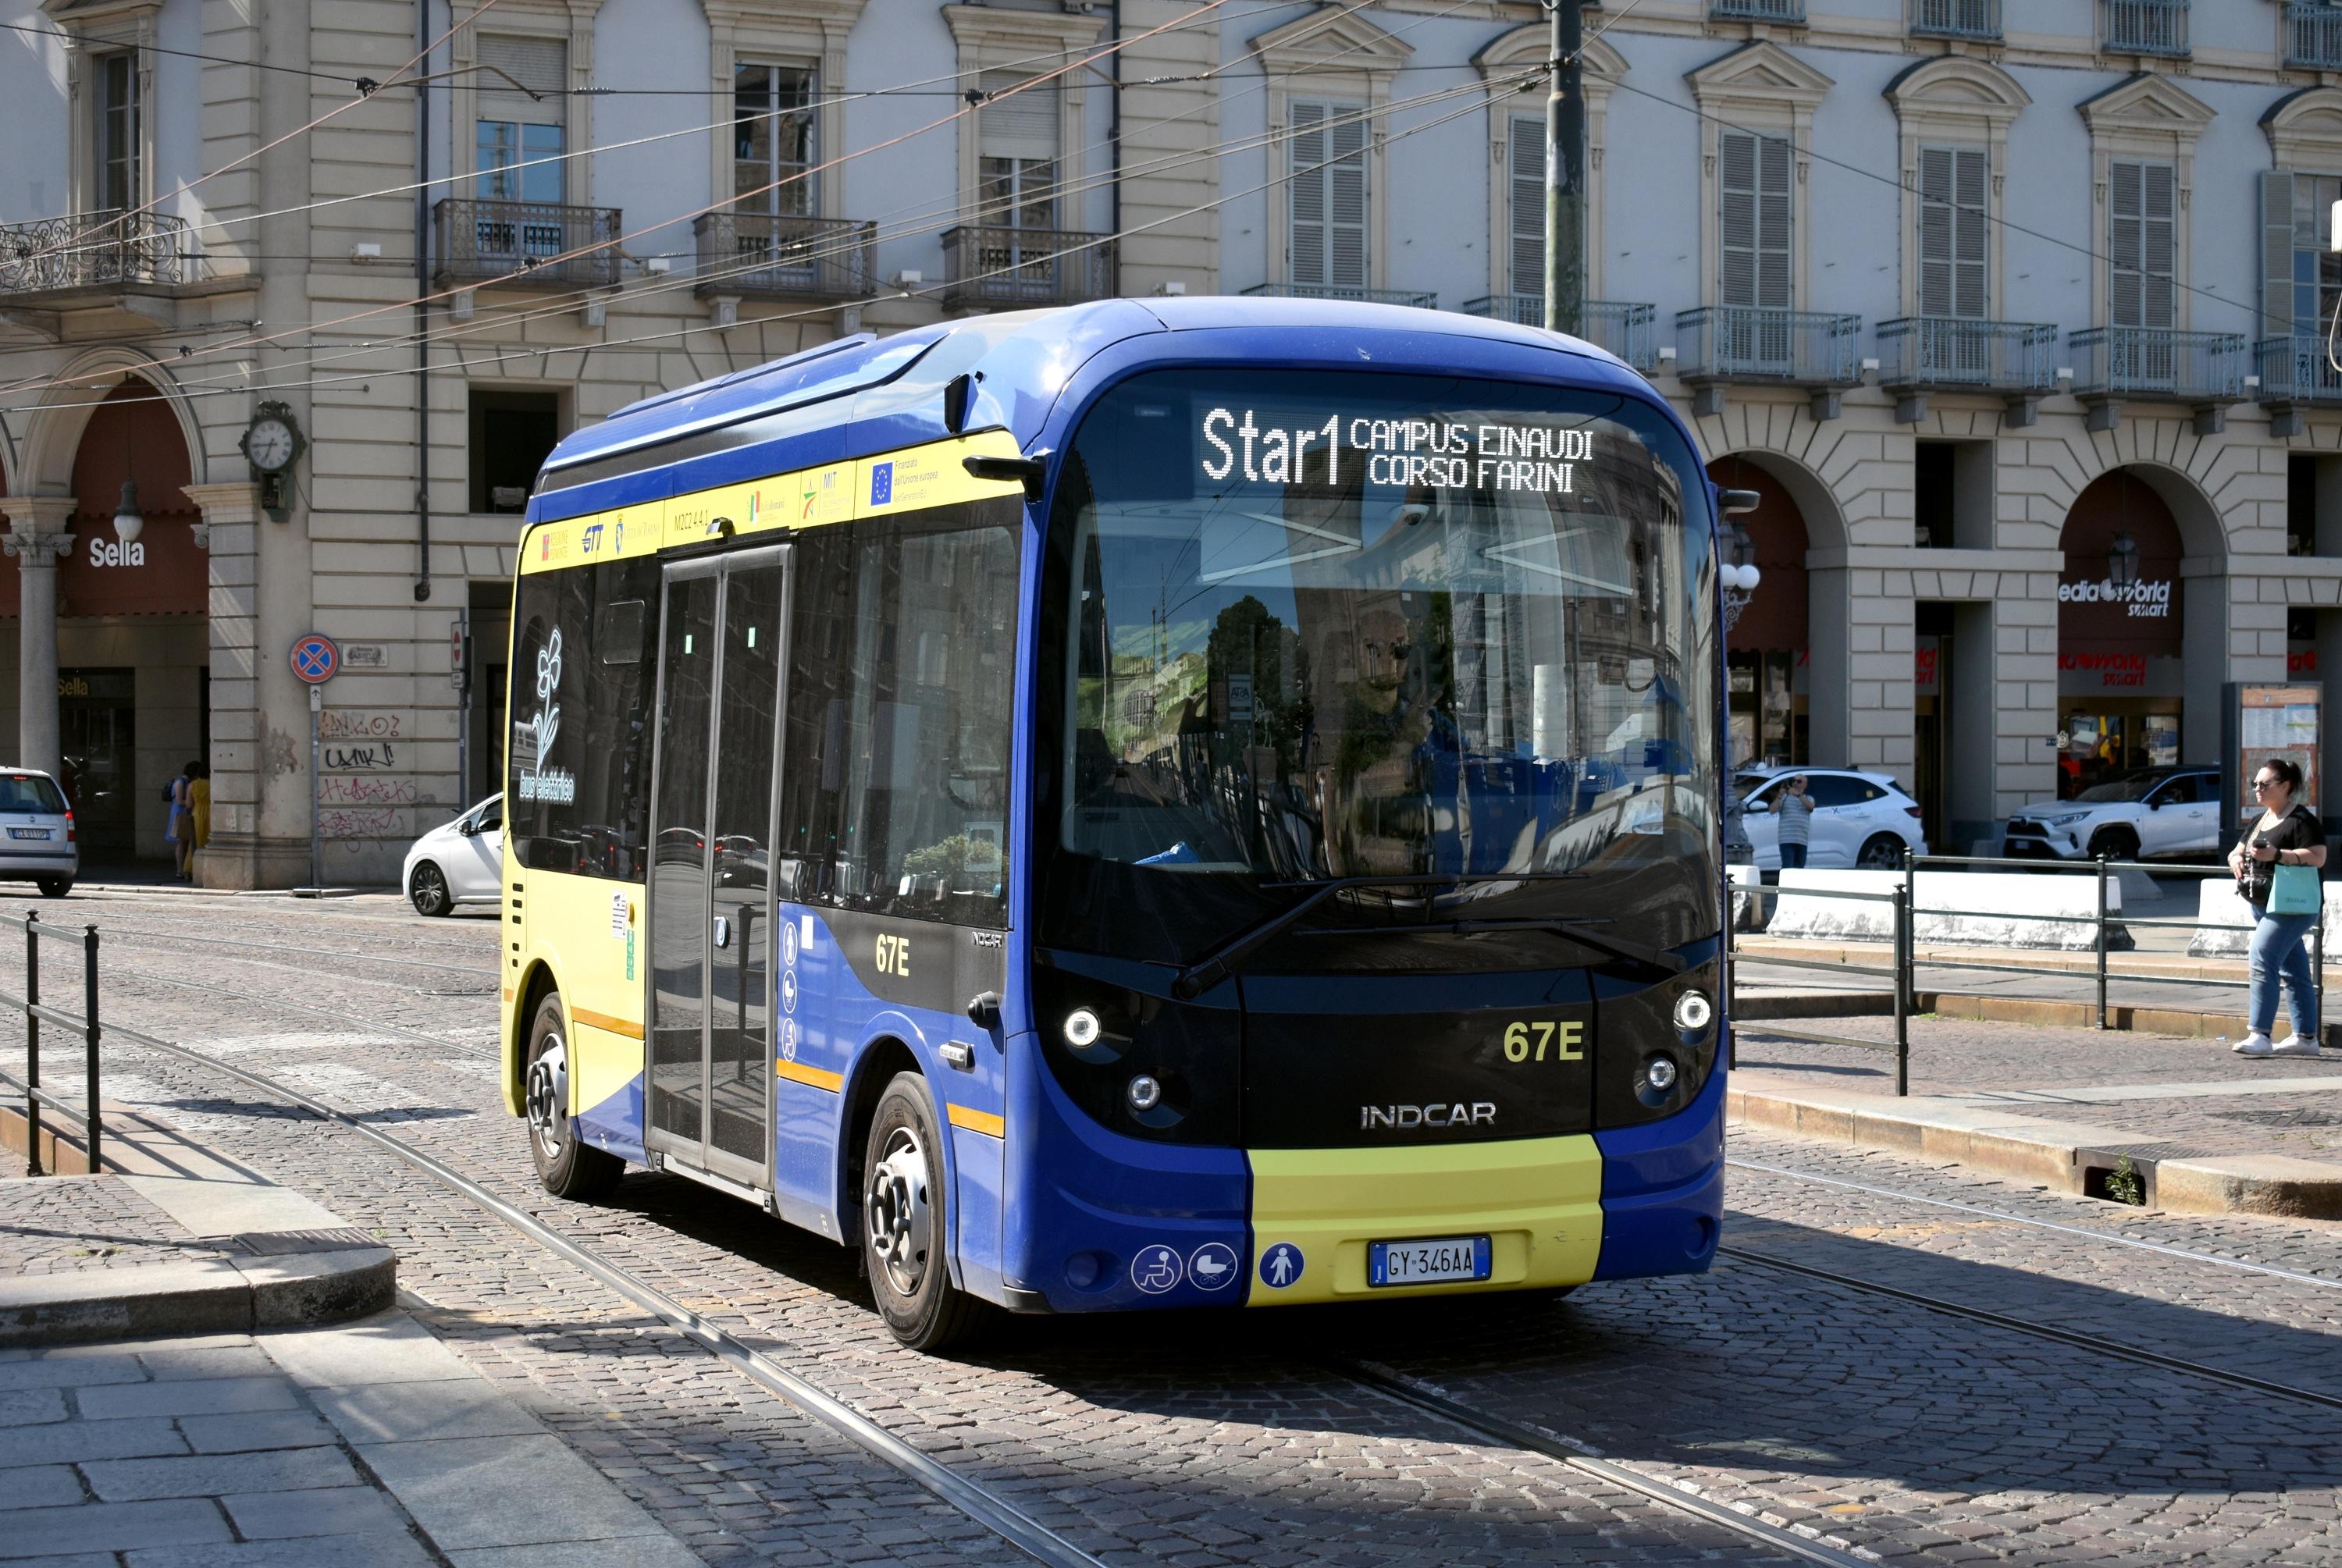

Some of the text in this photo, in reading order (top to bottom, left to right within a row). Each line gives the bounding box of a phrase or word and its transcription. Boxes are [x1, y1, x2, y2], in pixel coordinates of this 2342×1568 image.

[1351, 418, 1593, 460] CAMPUS EINAUDI
[895, 459, 918, 470] Finanziato
[920, 471, 938, 482] europea
[1369, 454, 1573, 492] CORSO FARINI
[824, 471, 837, 489] MIT
[674, 512, 692, 531] M2C2
[90, 536, 144, 567] Sella
[582, 524, 604, 553] GTT
[2058, 580, 2099, 602] edia
[2127, 603, 2169, 617] smart
[58, 677, 88, 696] Sella
[519, 770, 575, 802] bus elettrico
[876, 933, 909, 976] 67E
[1504, 1022, 1583, 1062] 67E
[1361, 1101, 1496, 1130] INDCAR
[1418, 1247, 1472, 1274] 346AA
